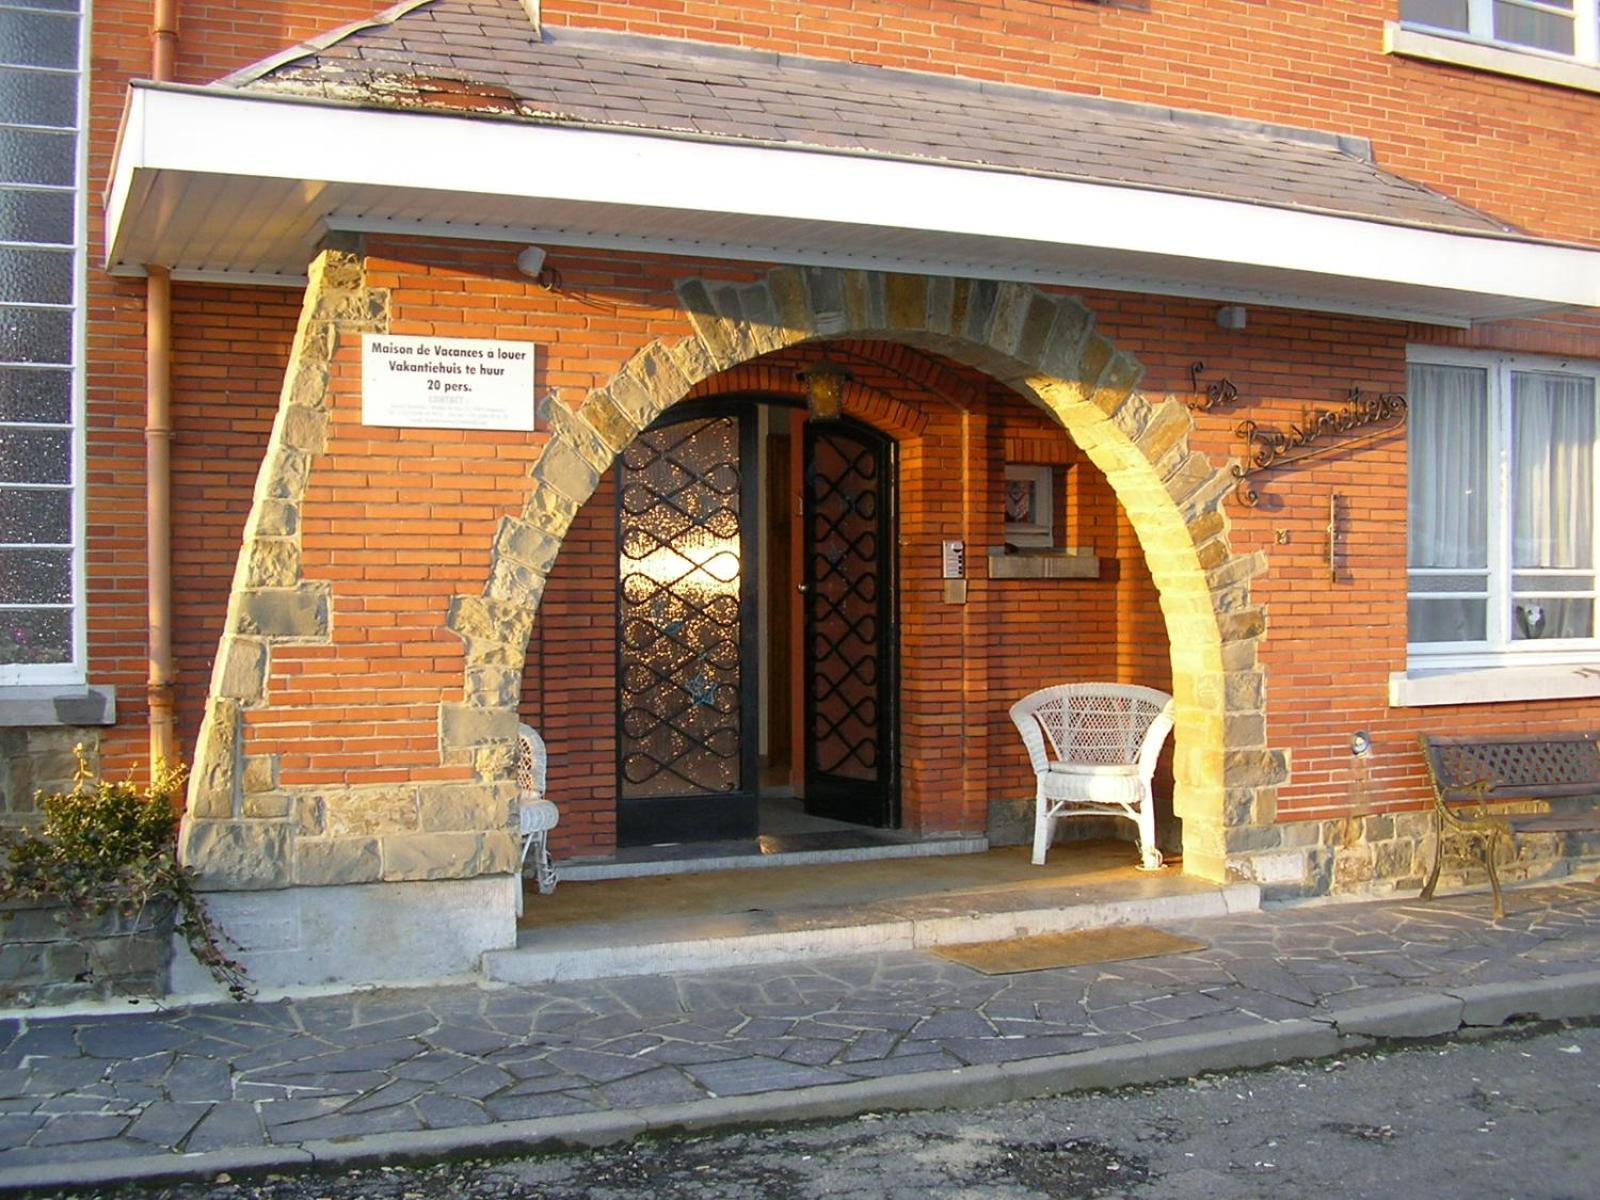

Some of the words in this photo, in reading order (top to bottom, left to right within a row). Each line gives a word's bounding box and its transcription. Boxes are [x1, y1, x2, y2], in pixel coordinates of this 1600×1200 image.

[371, 342, 413, 355] Maison
[416, 344, 431, 356] de
[434, 345, 484, 359] Vacances
[497, 348, 527, 361] louer
[388, 360, 462, 375] Vakantiehuis
[465, 364, 477, 375] te
[479, 364, 505, 377] huur
[427, 379, 441, 391] 20
[444, 382, 473, 393] pers.
[1187, 360, 1238, 411] Les
